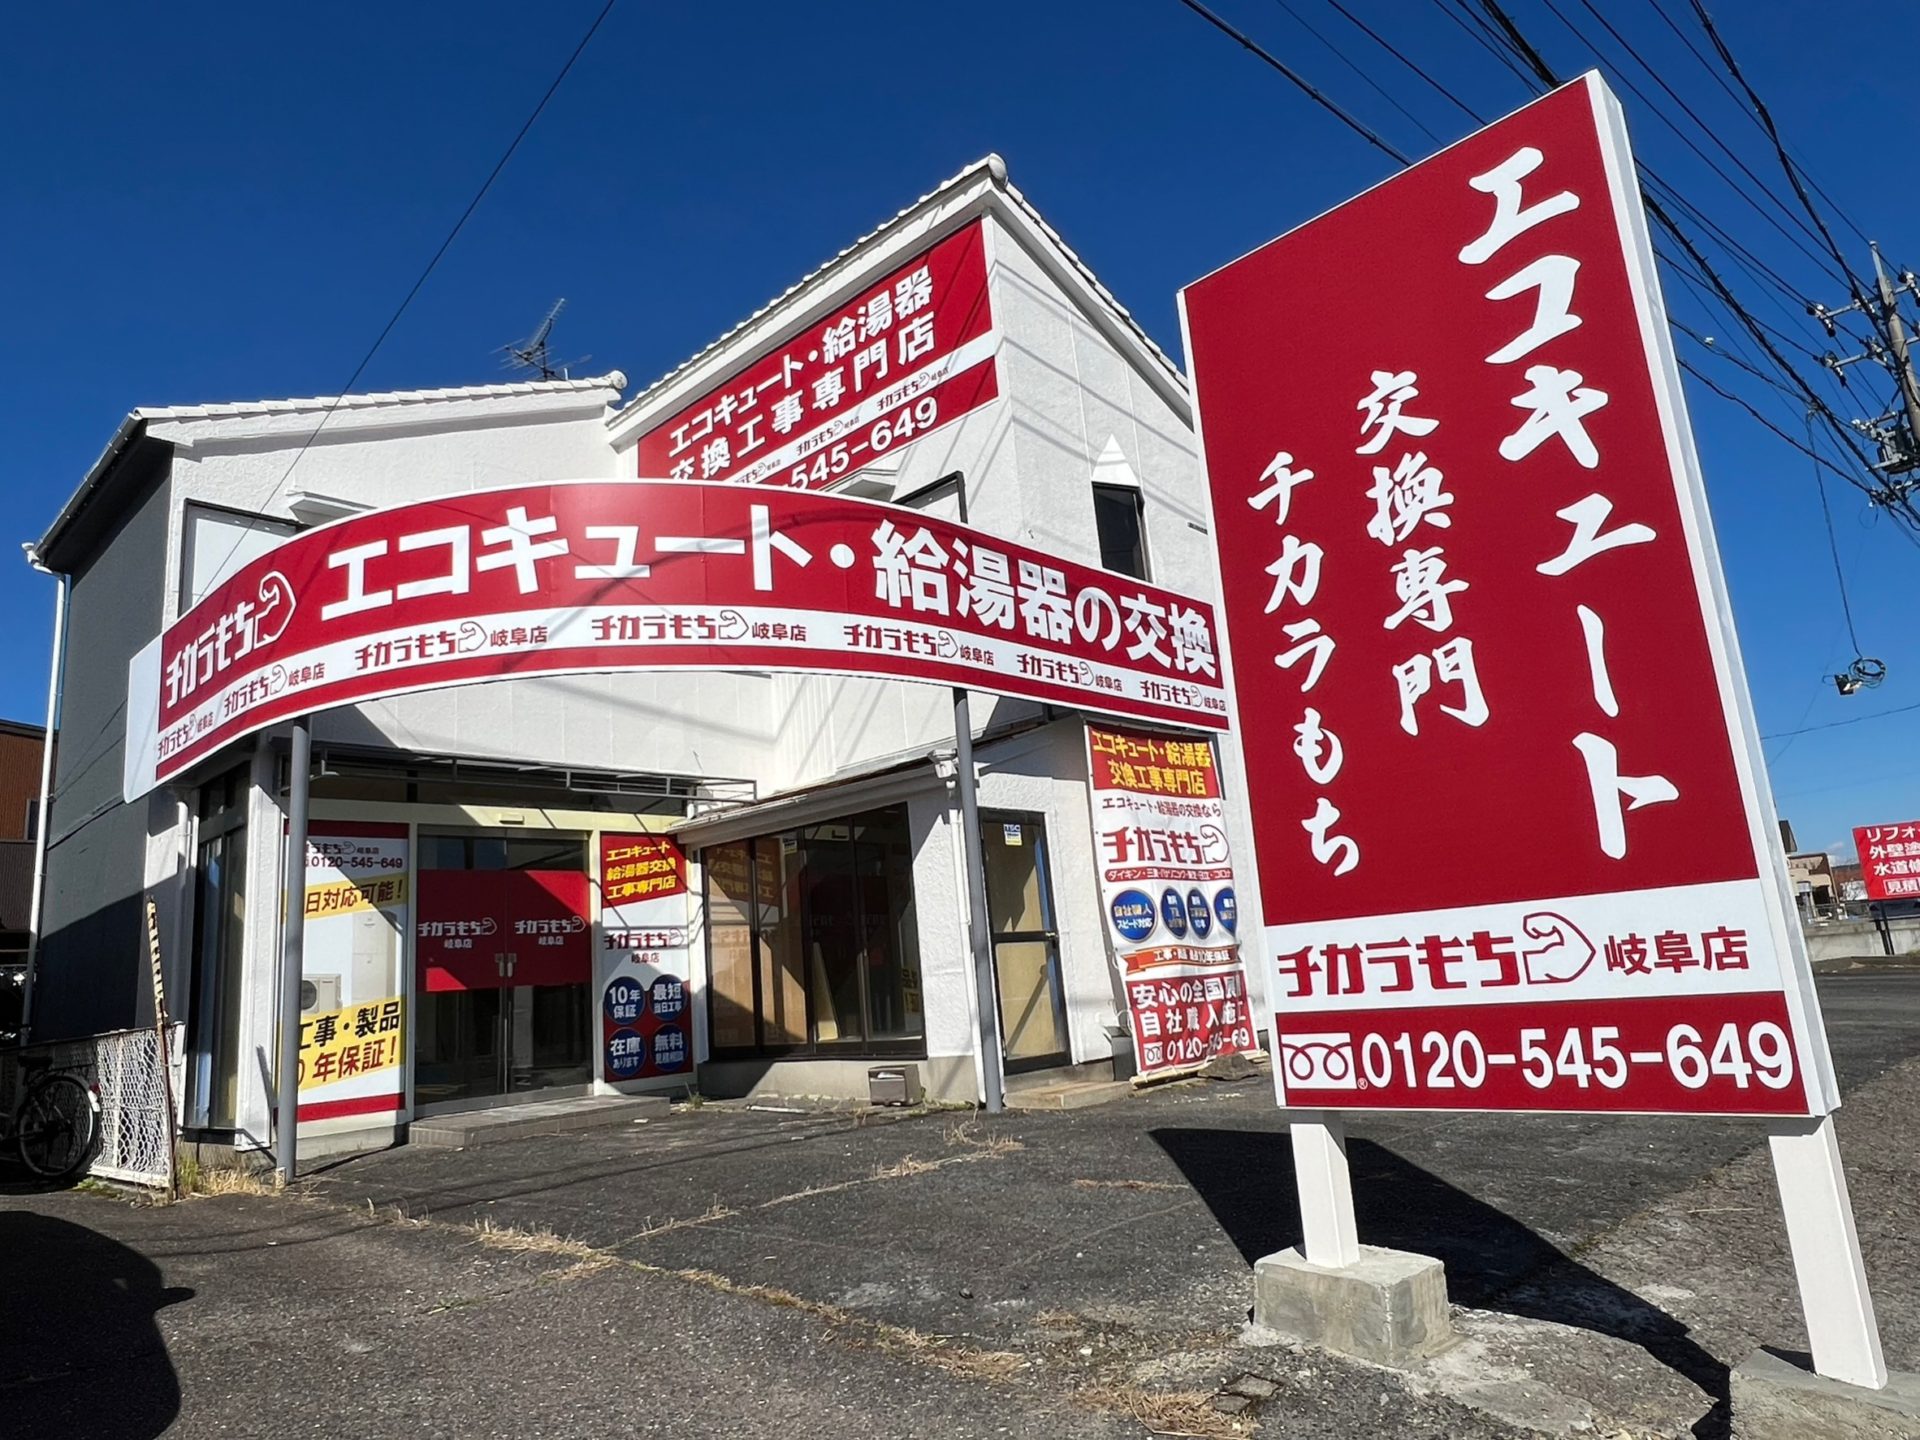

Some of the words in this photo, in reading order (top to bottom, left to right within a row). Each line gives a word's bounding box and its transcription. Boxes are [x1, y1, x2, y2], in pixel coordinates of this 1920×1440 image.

[668, 265, 934, 459] エコキュート・給湯器
[1457, 145, 1682, 861] エコキュート
[1354, 369, 1491, 736] 交換専門
[320, 503, 1217, 680] エコキュート・給湯器の交換
[354, 630, 457, 669] チカラもち
[490, 625, 548, 648] 岐阜店
[592, 613, 717, 642] チカラもち
[752, 622, 807, 643] 岐阜店
[843, 623, 937, 658] チカラもち
[959, 643, 995, 666] 岐阜店
[165, 600, 256, 709] チカラもち
[1016, 652, 1080, 689] チカラもち
[1095, 672, 1124, 693] 岐阜店
[1247, 452, 1361, 878] チカラもち
[223, 675, 271, 717] チカラもち
[288, 662, 325, 687] 岐阜店
[1140, 679, 1191, 707] チカラもち
[1107, 759, 1207, 796] 交換工事専門店
[606, 840, 671, 862] エコキュート
[1102, 826, 1203, 865] チカラもち
[607, 875, 677, 900] 工事専門店
[418, 920, 482, 937] チカラもち
[514, 919, 573, 935] チカラもち
[1277, 930, 1521, 998] チカラもち
[1603, 925, 1750, 976] 岐阜店
[609, 985, 641, 1004] 10年
[653, 982, 682, 1001] 最短
[610, 1036, 641, 1057] 在庫
[1360, 1020, 1794, 1090] 0120-545-649
